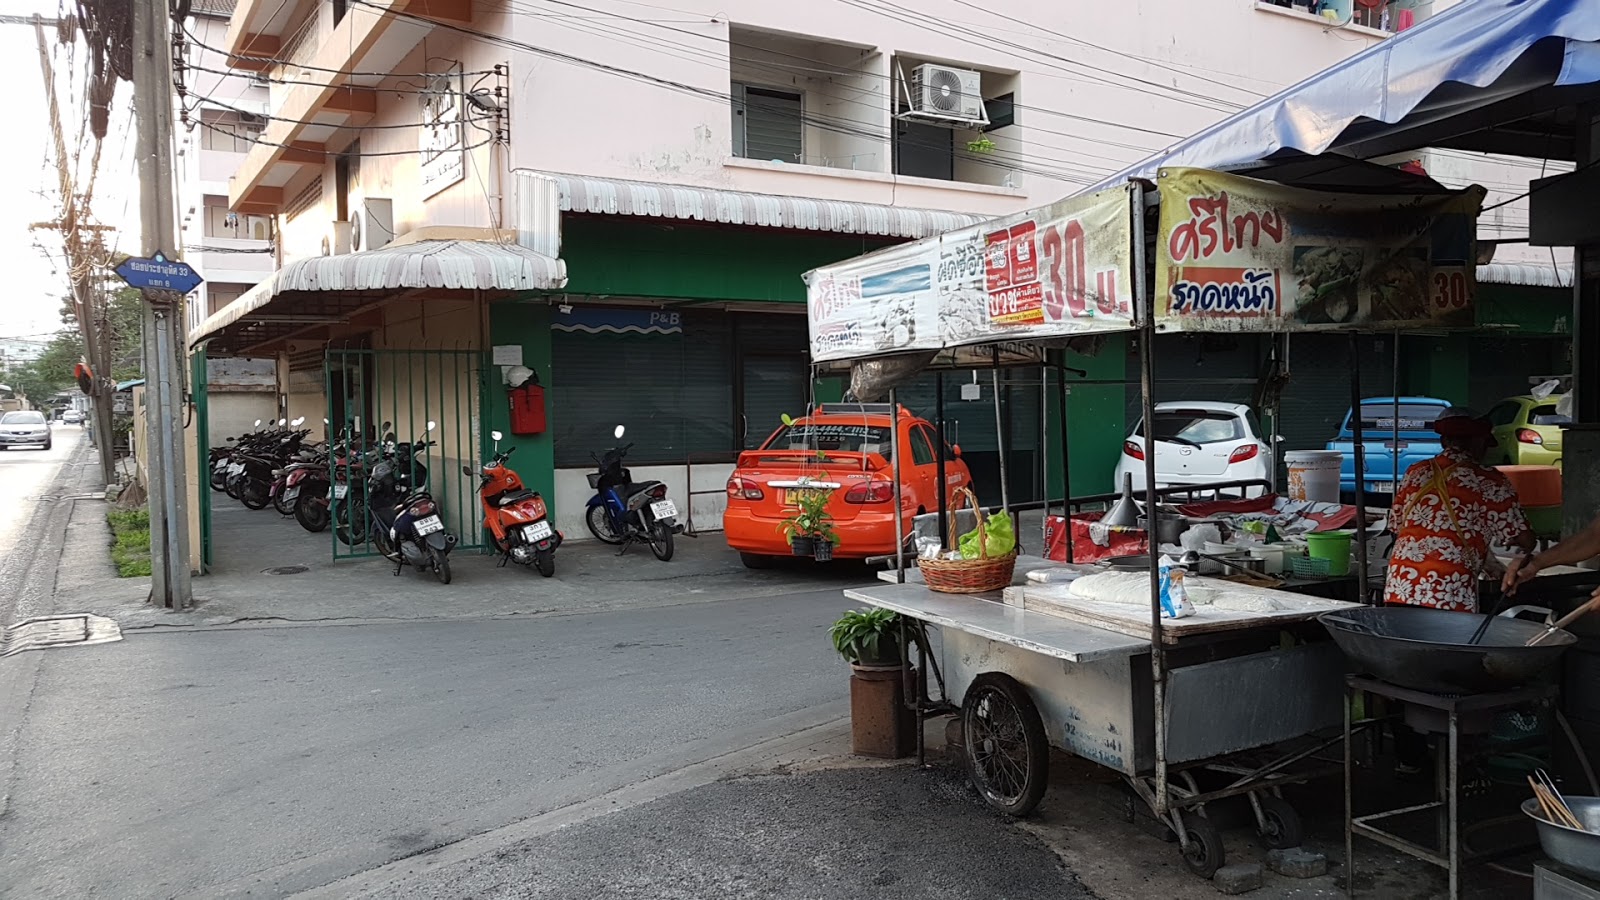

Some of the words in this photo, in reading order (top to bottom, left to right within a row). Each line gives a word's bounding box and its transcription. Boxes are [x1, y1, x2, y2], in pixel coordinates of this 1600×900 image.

[179, 267, 188, 277] 33
[1042, 218, 1086, 321] 30
[1173, 269, 1274, 311] ราดหน้า
[650, 312, 680, 324] P&B
